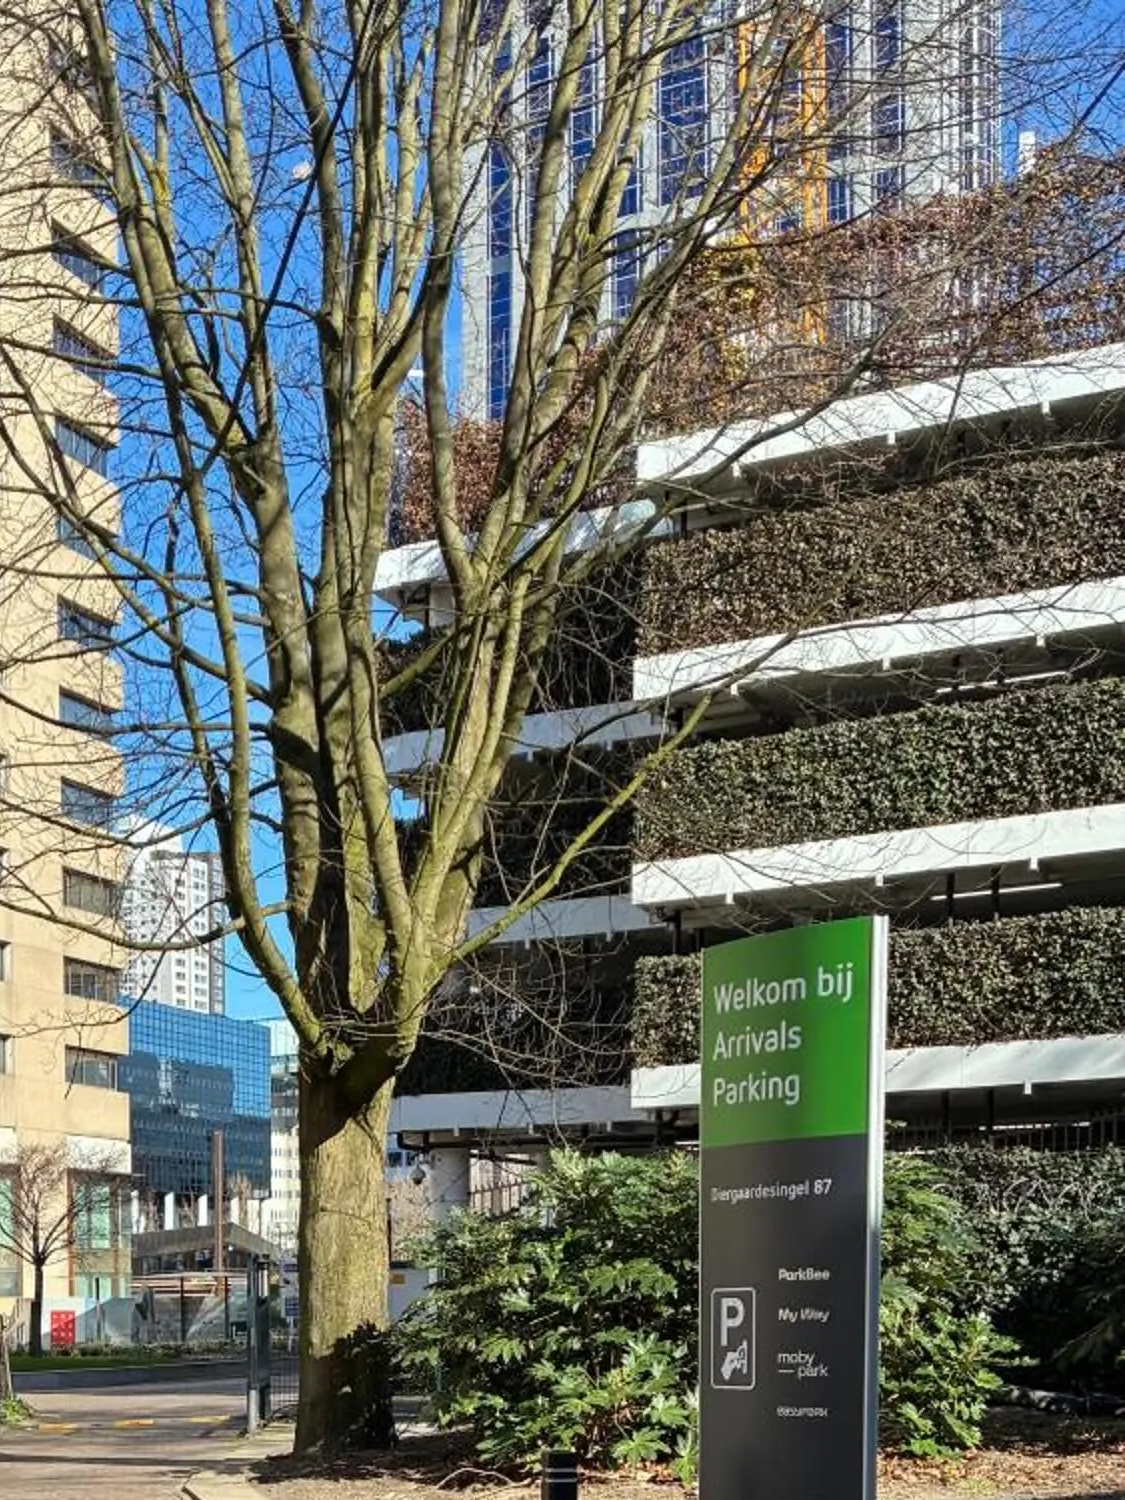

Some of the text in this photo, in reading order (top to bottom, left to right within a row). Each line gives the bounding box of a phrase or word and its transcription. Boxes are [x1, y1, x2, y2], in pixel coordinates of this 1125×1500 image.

[714, 962, 853, 1014] Welkom bij
[713, 1020, 801, 1060] Arrivals
[713, 1071, 800, 1107] Parking
[711, 1179, 832, 1204] Diergaardesingel 87
[778, 1268, 830, 1281] ParkBee
[720, 1297, 745, 1346] P
[778, 1308, 797, 1322] My
[778, 1350, 815, 1367] moby
[798, 1364, 828, 1379] park
